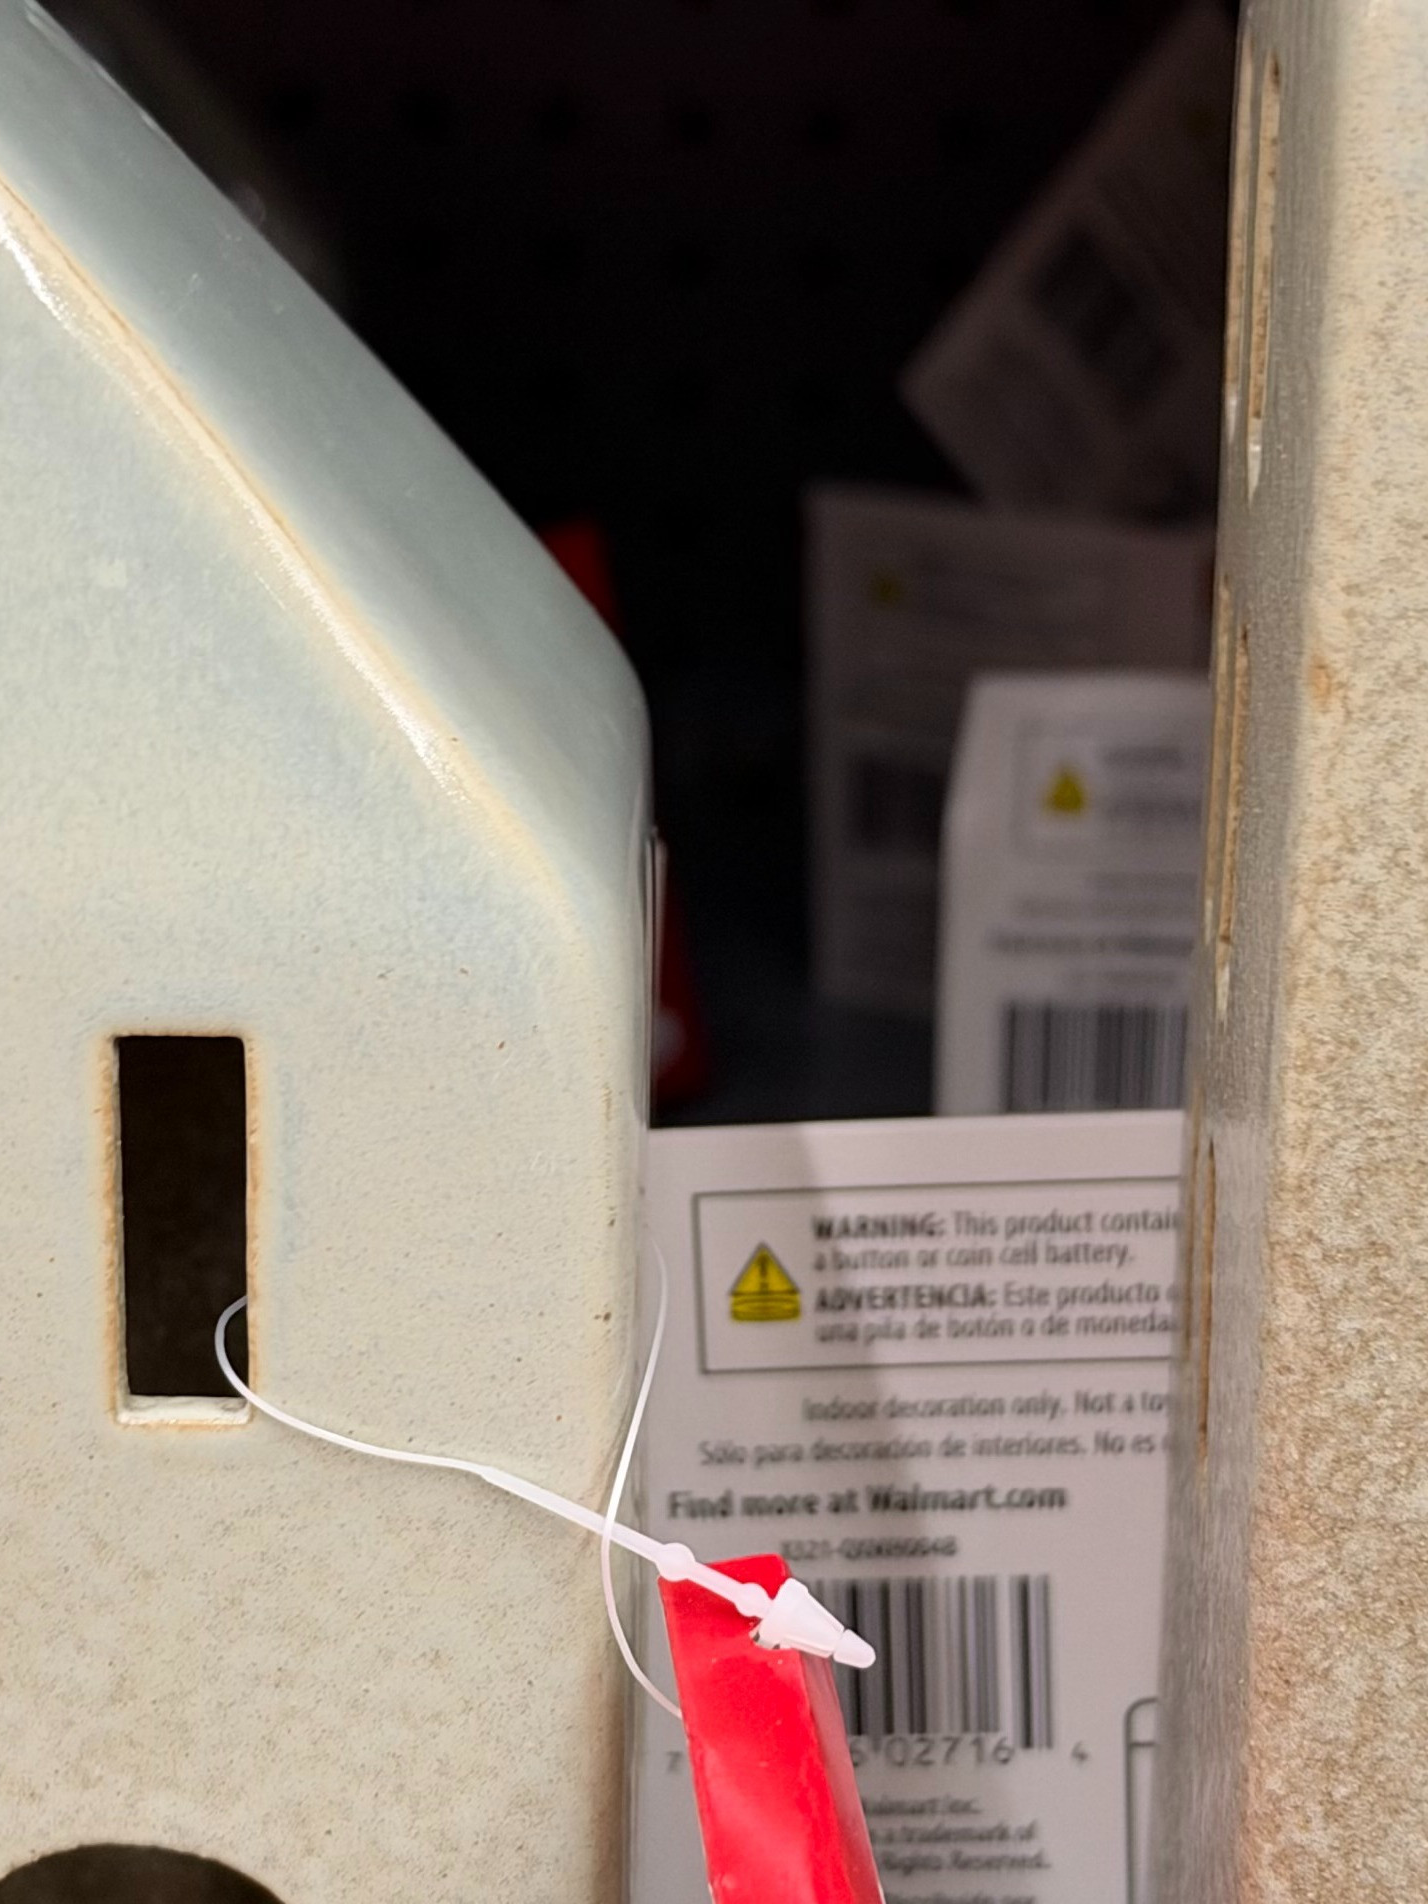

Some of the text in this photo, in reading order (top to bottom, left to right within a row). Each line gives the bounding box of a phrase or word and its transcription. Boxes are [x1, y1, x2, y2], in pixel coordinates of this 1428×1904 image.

[813, 1211, 945, 1239] WARNING:
[953, 1210, 998, 1236] This
[1005, 1209, 1092, 1239] product
[813, 1240, 1135, 1270] a button or coin cell battery.
[814, 1282, 997, 1312] ADVERTENCIA:
[1003, 1281, 1050, 1307] Este
[1056, 1279, 1160, 1311] producto
[815, 1320, 859, 1343] una
[864, 1317, 906, 1346] pila
[913, 1314, 941, 1339] de
[946, 1312, 1014, 1338] botón
[1021, 1317, 1034, 1335] o
[1040, 1312, 1070, 1336] de
[802, 1397, 881, 1422] Indoor
[886, 1393, 1005, 1420] decoration
[1011, 1390, 1068, 1421] only.
[1074, 1390, 1116, 1414] Not
[1122, 1394, 1135, 1413] a
[754, 1444, 805, 1469] para
[940, 1436, 967, 1458] de
[975, 1431, 1087, 1457] interiores.
[1094, 1431, 1125, 1454] No
[1131, 1434, 1156, 1454] es
[668, 1483, 1068, 1520] Find more at Walmart.com
